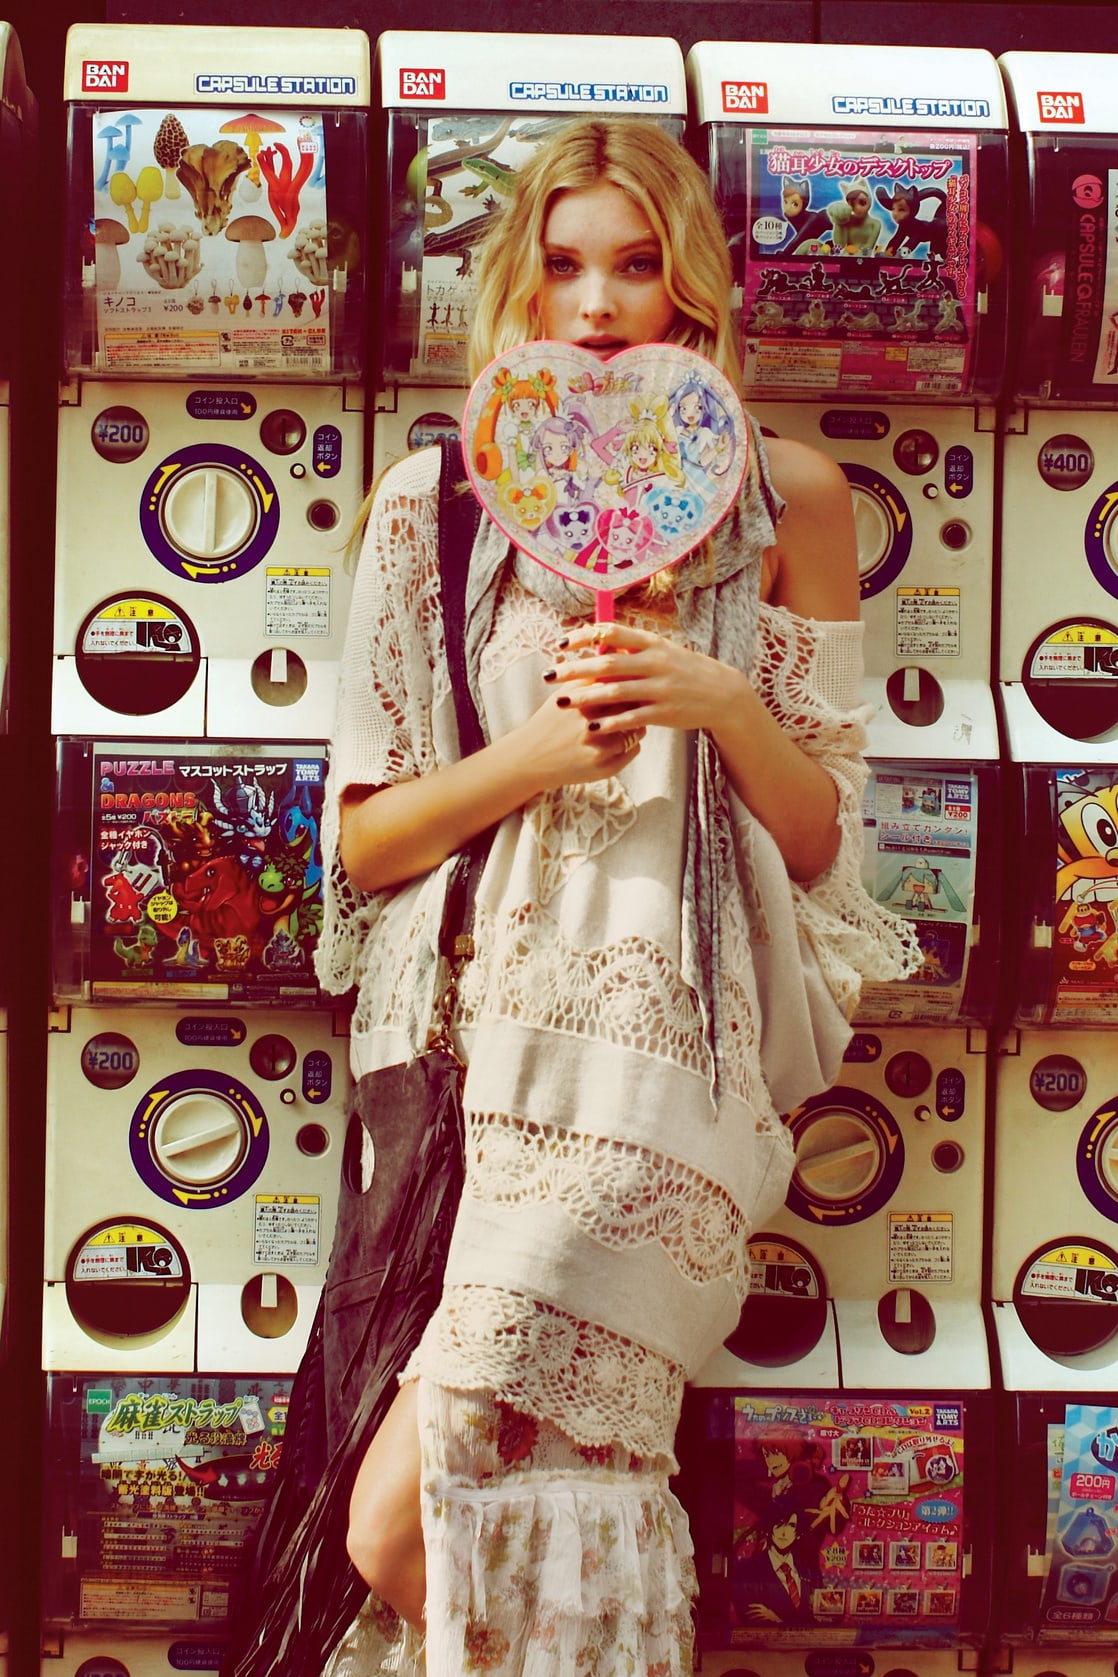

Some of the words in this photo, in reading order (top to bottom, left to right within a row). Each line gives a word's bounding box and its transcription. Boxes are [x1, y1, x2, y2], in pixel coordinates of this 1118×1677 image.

[86, 64, 125, 76] BAN
[86, 76, 117, 87] DAI
[403, 72, 442, 84] BAN
[198, 76, 278, 92] CAPSULE
[281, 78, 355, 94] STATION
[403, 83, 434, 96] DAI
[725, 85, 764, 98] BAN
[511, 84, 592, 100] CAPSULE
[594, 85, 668, 102] STATION
[726, 97, 758, 110] DAI
[834, 96, 915, 115] CAPSULE
[917, 98, 990, 117] STATION
[1040, 95, 1080, 108] BAN
[1042, 106, 1074, 119] DAI
[769, 152, 953, 180] 猫耳少女のデスクトップ
[104, 296, 136, 307] キノコ
[164, 304, 184, 312] ¥200
[98, 424, 144, 444] ¥200
[317, 433, 339, 441] コイン
[316, 452, 338, 460] ボタン
[949, 454, 970, 462] コイン
[1044, 454, 1089, 473] ¥400
[948, 473, 970, 481] ボタン
[100, 760, 175, 777] PUZZLE
[178, 764, 288, 778] マスコットストラップ
[295, 774, 320, 782] ARTS
[100, 792, 196, 809] DRAGONS
[881, 822, 968, 836] 組み立てカンタン!
[881, 832, 931, 844] シール付き
[101, 841, 148, 850] ジャック付き
[88, 1051, 134, 1070] ¥200
[308, 1059, 329, 1067] コイン
[307, 1078, 329, 1086] ボタン
[1034, 1072, 1079, 1092] ¥200
[110, 1396, 242, 1430] 麻雀ストラップ
[909, 1408, 931, 1416] Vol.2
[1076, 1474, 1110, 1488] 200円
